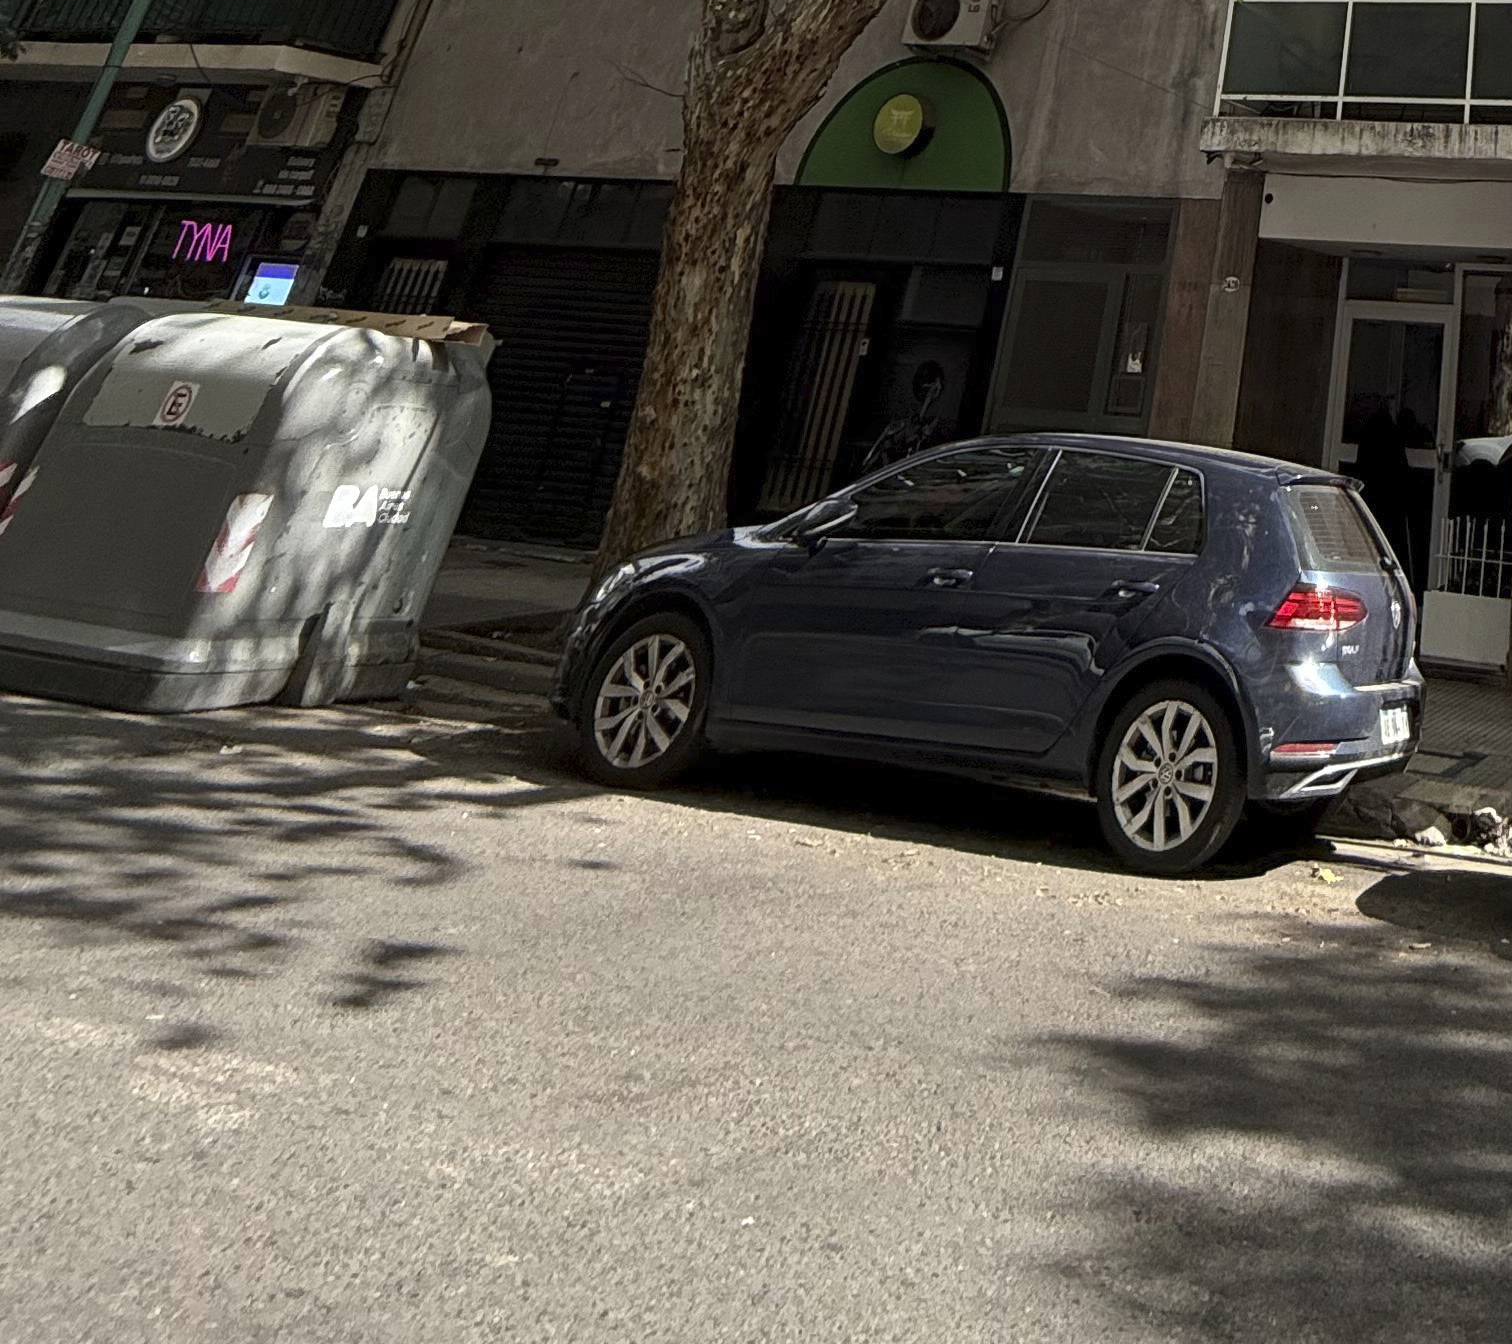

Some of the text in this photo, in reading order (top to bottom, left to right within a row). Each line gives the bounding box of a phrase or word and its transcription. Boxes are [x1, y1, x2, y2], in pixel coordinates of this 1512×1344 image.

[60, 140, 98, 161] TAROT
[172, 219, 233, 263] TYNA
[322, 484, 379, 528] BA
